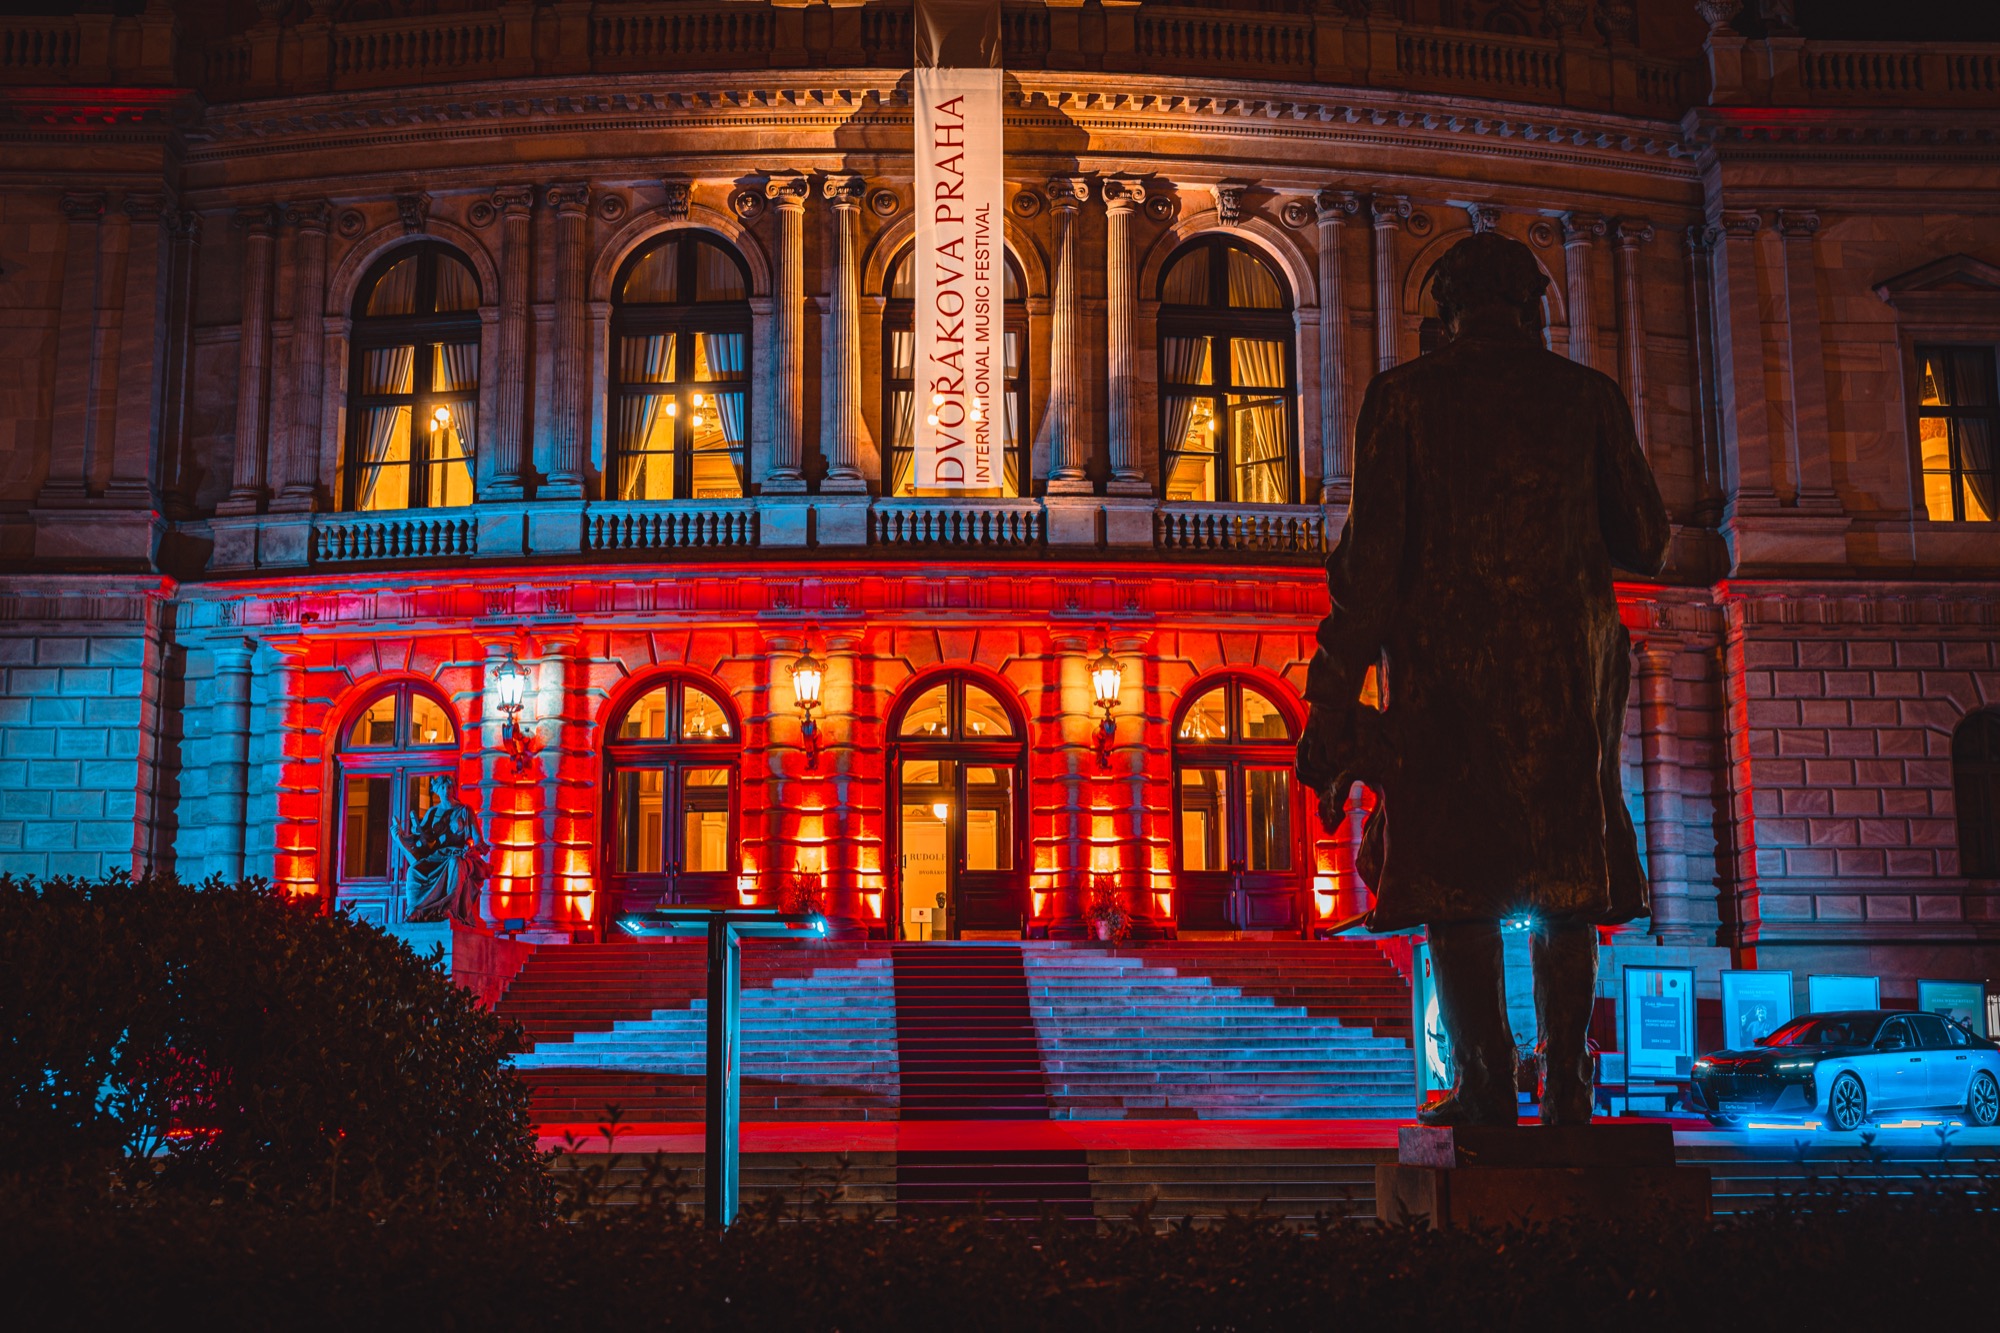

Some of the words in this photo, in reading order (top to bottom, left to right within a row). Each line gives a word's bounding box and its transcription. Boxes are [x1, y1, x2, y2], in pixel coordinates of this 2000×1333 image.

[935, 94, 965, 224] PRAHA
[975, 202, 990, 281] FESTIVAL
[929, 236, 966, 485] DVOŘÁKOVA
[975, 285, 990, 342] MUSIC
